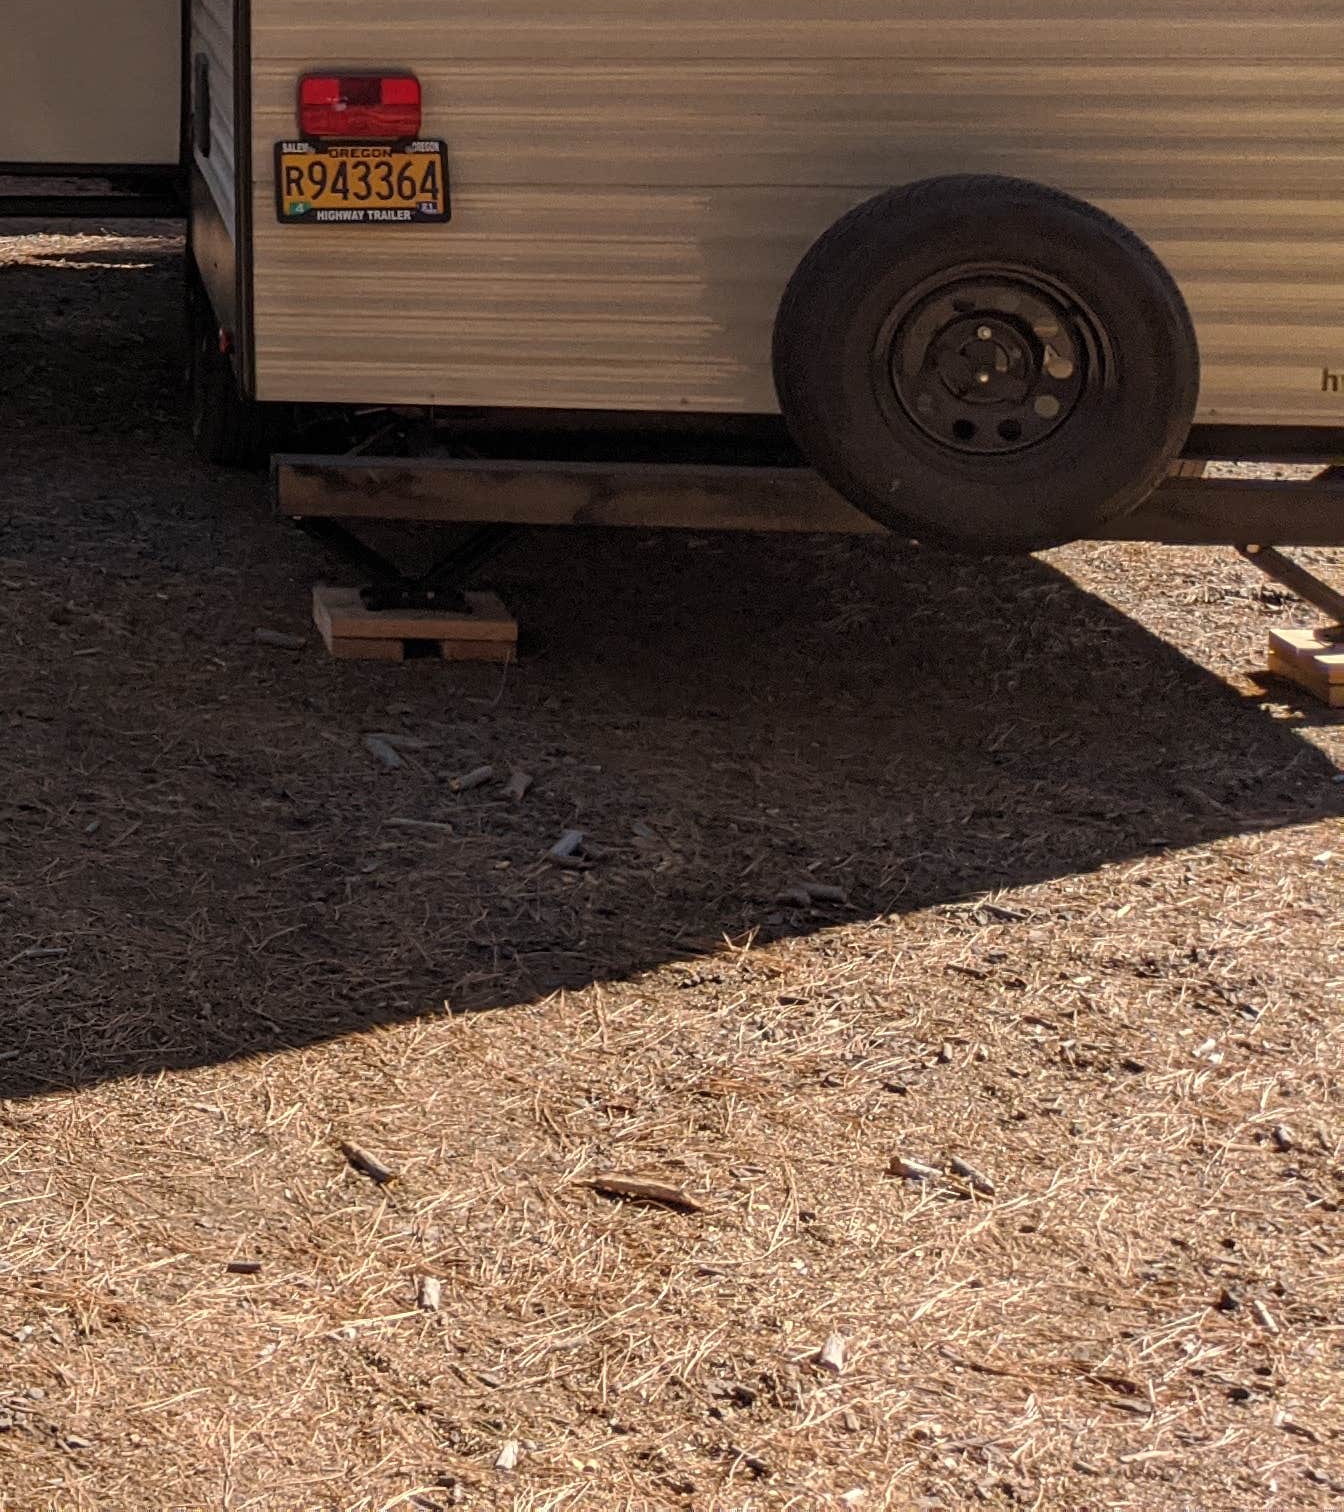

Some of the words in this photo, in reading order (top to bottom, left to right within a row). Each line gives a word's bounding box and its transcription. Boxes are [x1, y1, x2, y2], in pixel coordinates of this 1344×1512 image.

[328, 148, 393, 158] OREGON
[286, 160, 438, 201] R943364
[316, 210, 364, 221] HIGHWAY
[367, 210, 411, 220] TRAILER
